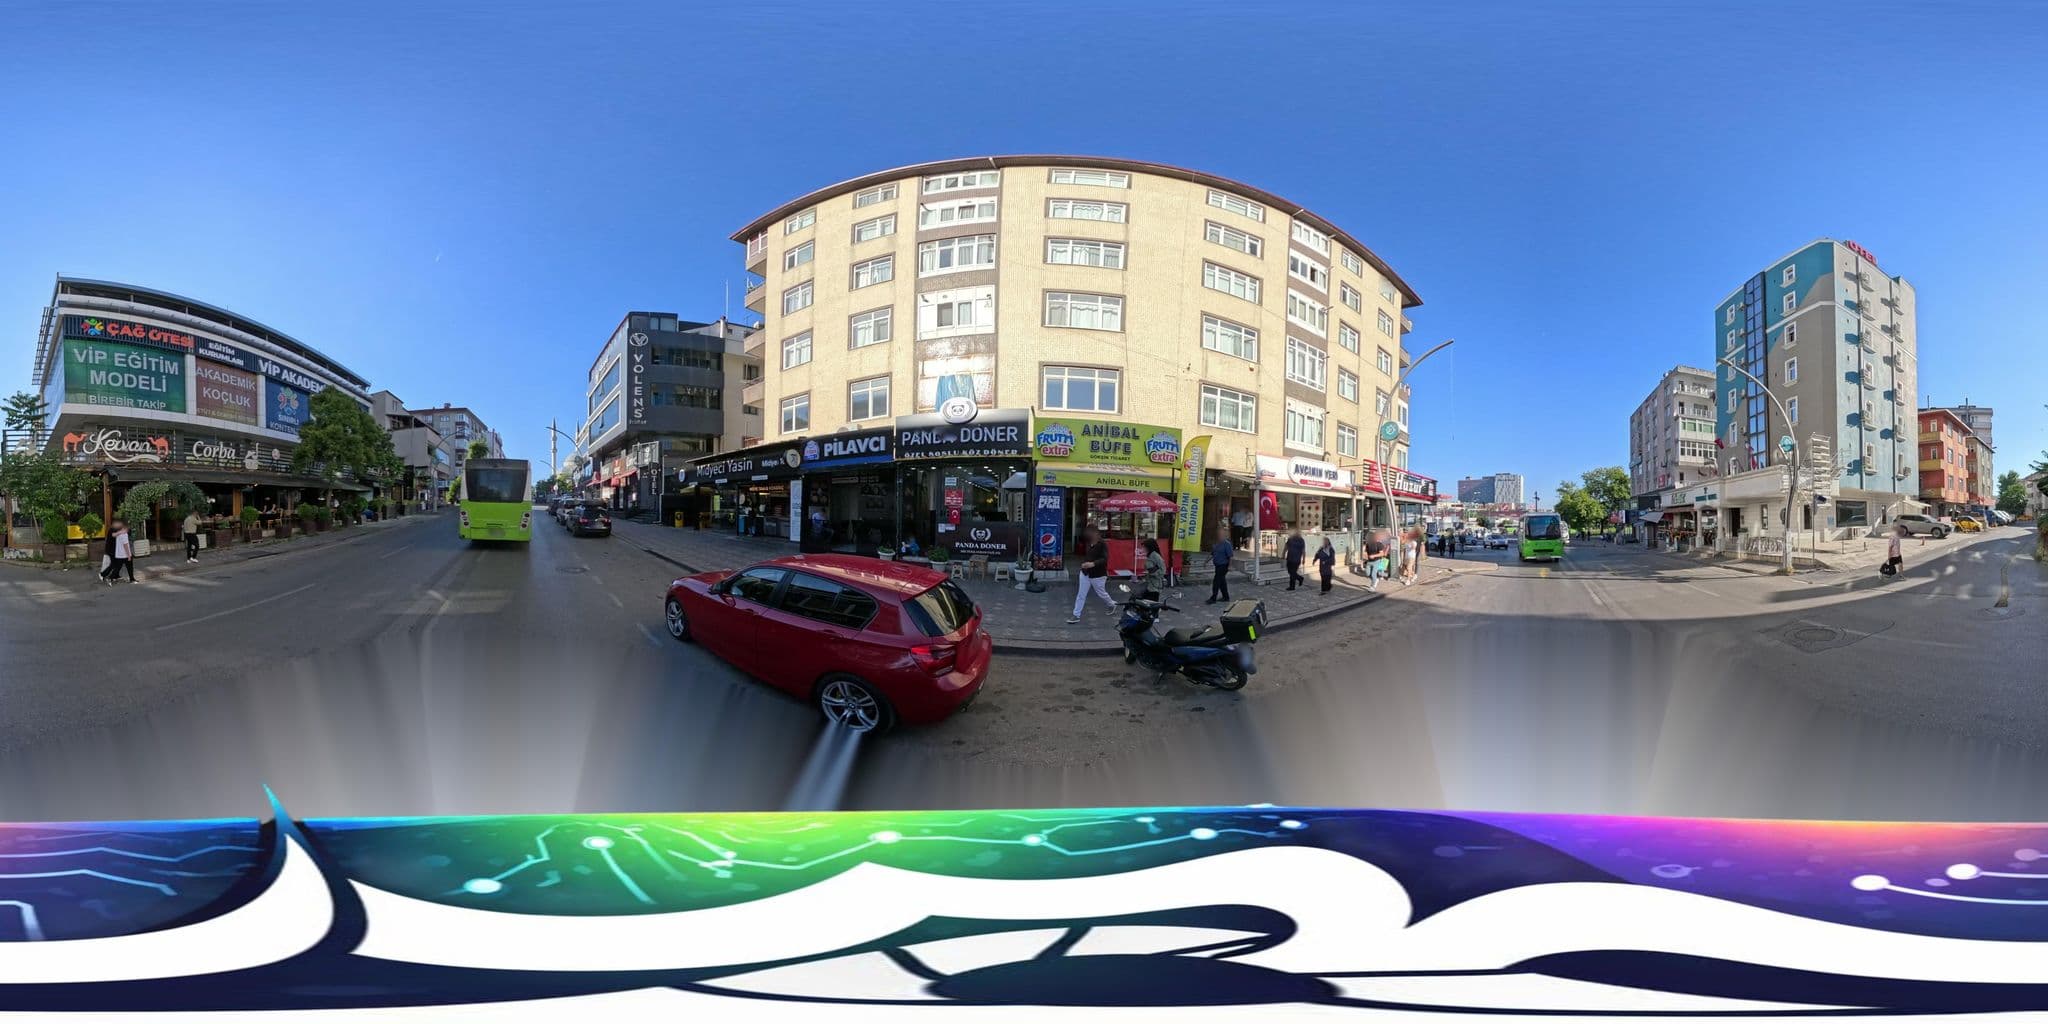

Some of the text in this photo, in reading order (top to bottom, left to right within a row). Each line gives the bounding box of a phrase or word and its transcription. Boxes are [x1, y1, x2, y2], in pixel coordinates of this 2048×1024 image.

[106, 322, 146, 338] ÇAĞ
[73, 346, 179, 375] VİP EĞİTİM
[259, 359, 280, 376] VİP
[90, 369, 167, 392] MODELİ
[196, 368, 256, 391] AKADEMİK
[89, 394, 166, 409] BİREBİR TAKİP
[203, 387, 251, 407] KOÇLUK
[960, 424, 1018, 443] DÖNER
[1037, 431, 1074, 446] FRUTTI
[1081, 422, 1140, 440] ANİBAL
[83, 428, 157, 462] Kervan
[823, 436, 886, 457] PİLAVCI
[1042, 446, 1068, 456] extra
[1090, 438, 1132, 454] BÜFE
[1152, 452, 1175, 462] extra
[696, 457, 753, 478] Midyeci Yasin
[1096, 476, 1150, 488] ANİBAL BÜFE
[1178, 493, 1190, 539] EV YAPIMI
[1188, 498, 1199, 536] TADINDA
[980, 541, 1007, 550] DÖNER
